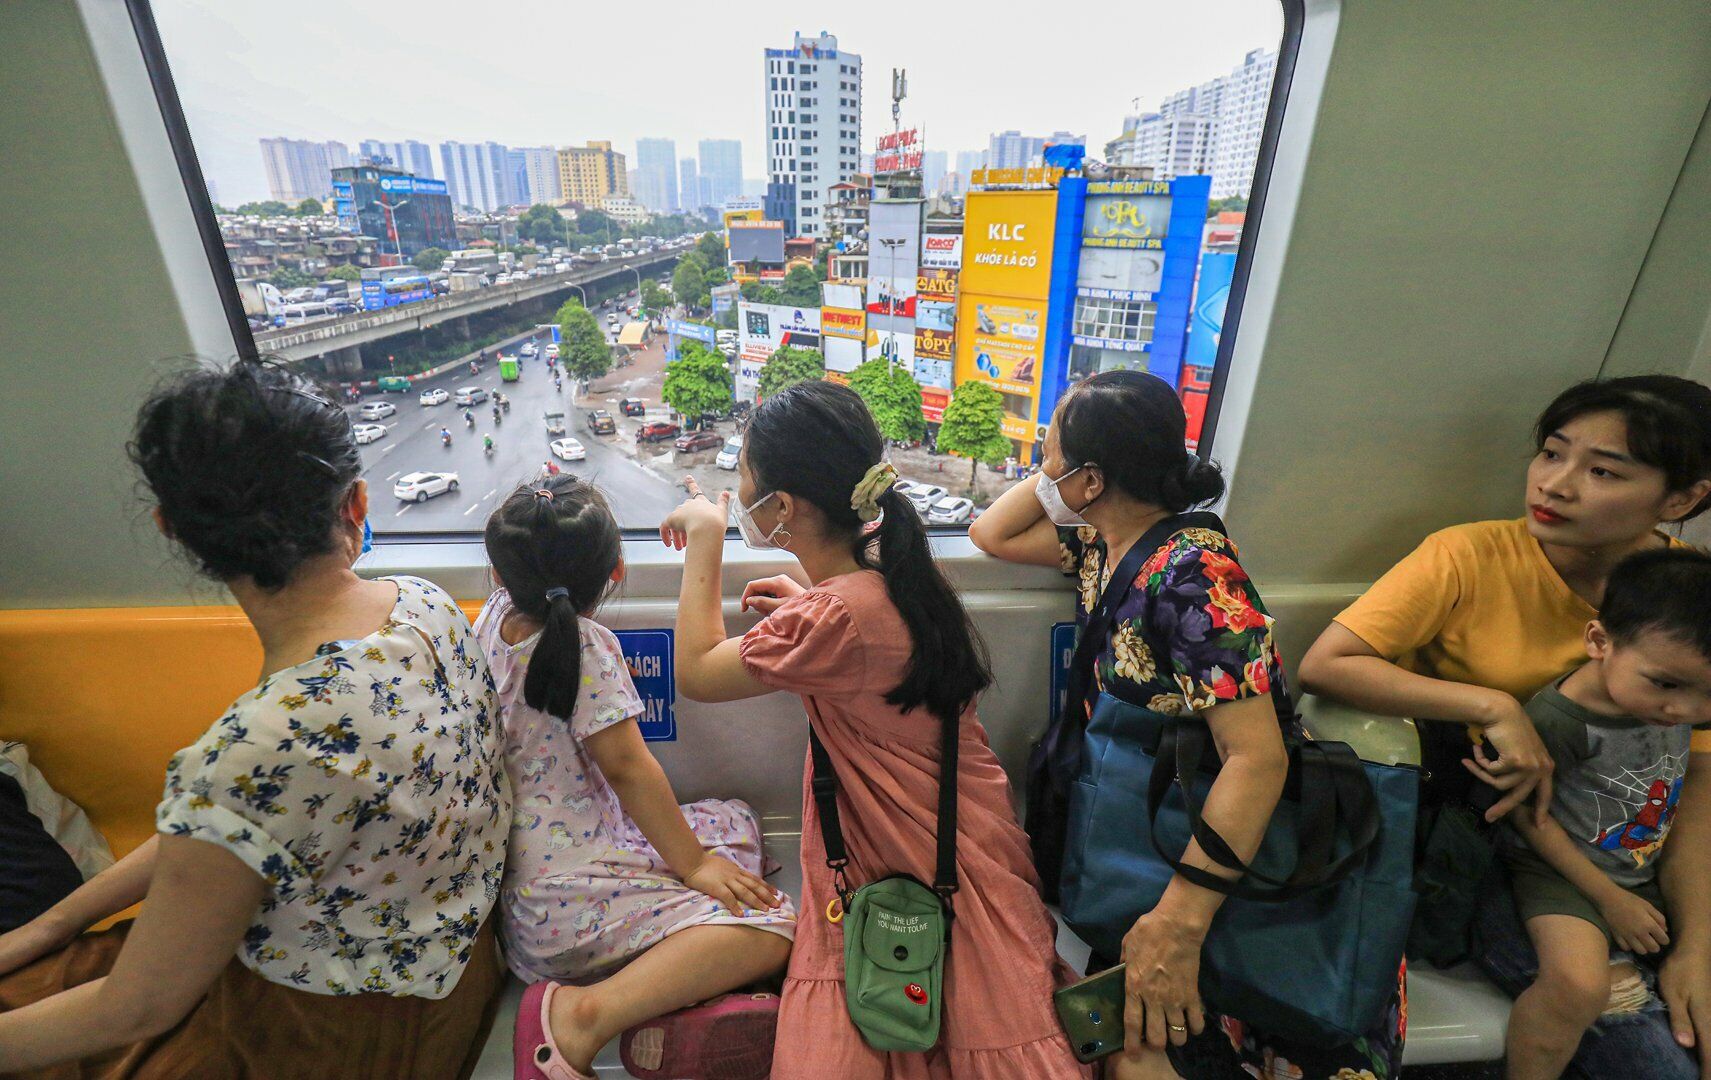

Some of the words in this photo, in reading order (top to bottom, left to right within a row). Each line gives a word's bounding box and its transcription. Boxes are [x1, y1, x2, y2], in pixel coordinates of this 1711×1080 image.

[1124, 182, 1153, 194] BEAUTY
[1154, 182, 1169, 194] SPA
[988, 224, 1025, 241] KLC
[1119, 239, 1147, 248] BEAUTY
[1147, 239, 1162, 249] SPA
[1019, 250, 1037, 268] CÓ
[927, 279, 956, 293] ATG
[915, 336, 951, 352] TOPY
[877, 919, 889, 929] YOU
[889, 924, 907, 933] WANT
[893, 916, 906, 925] THE
